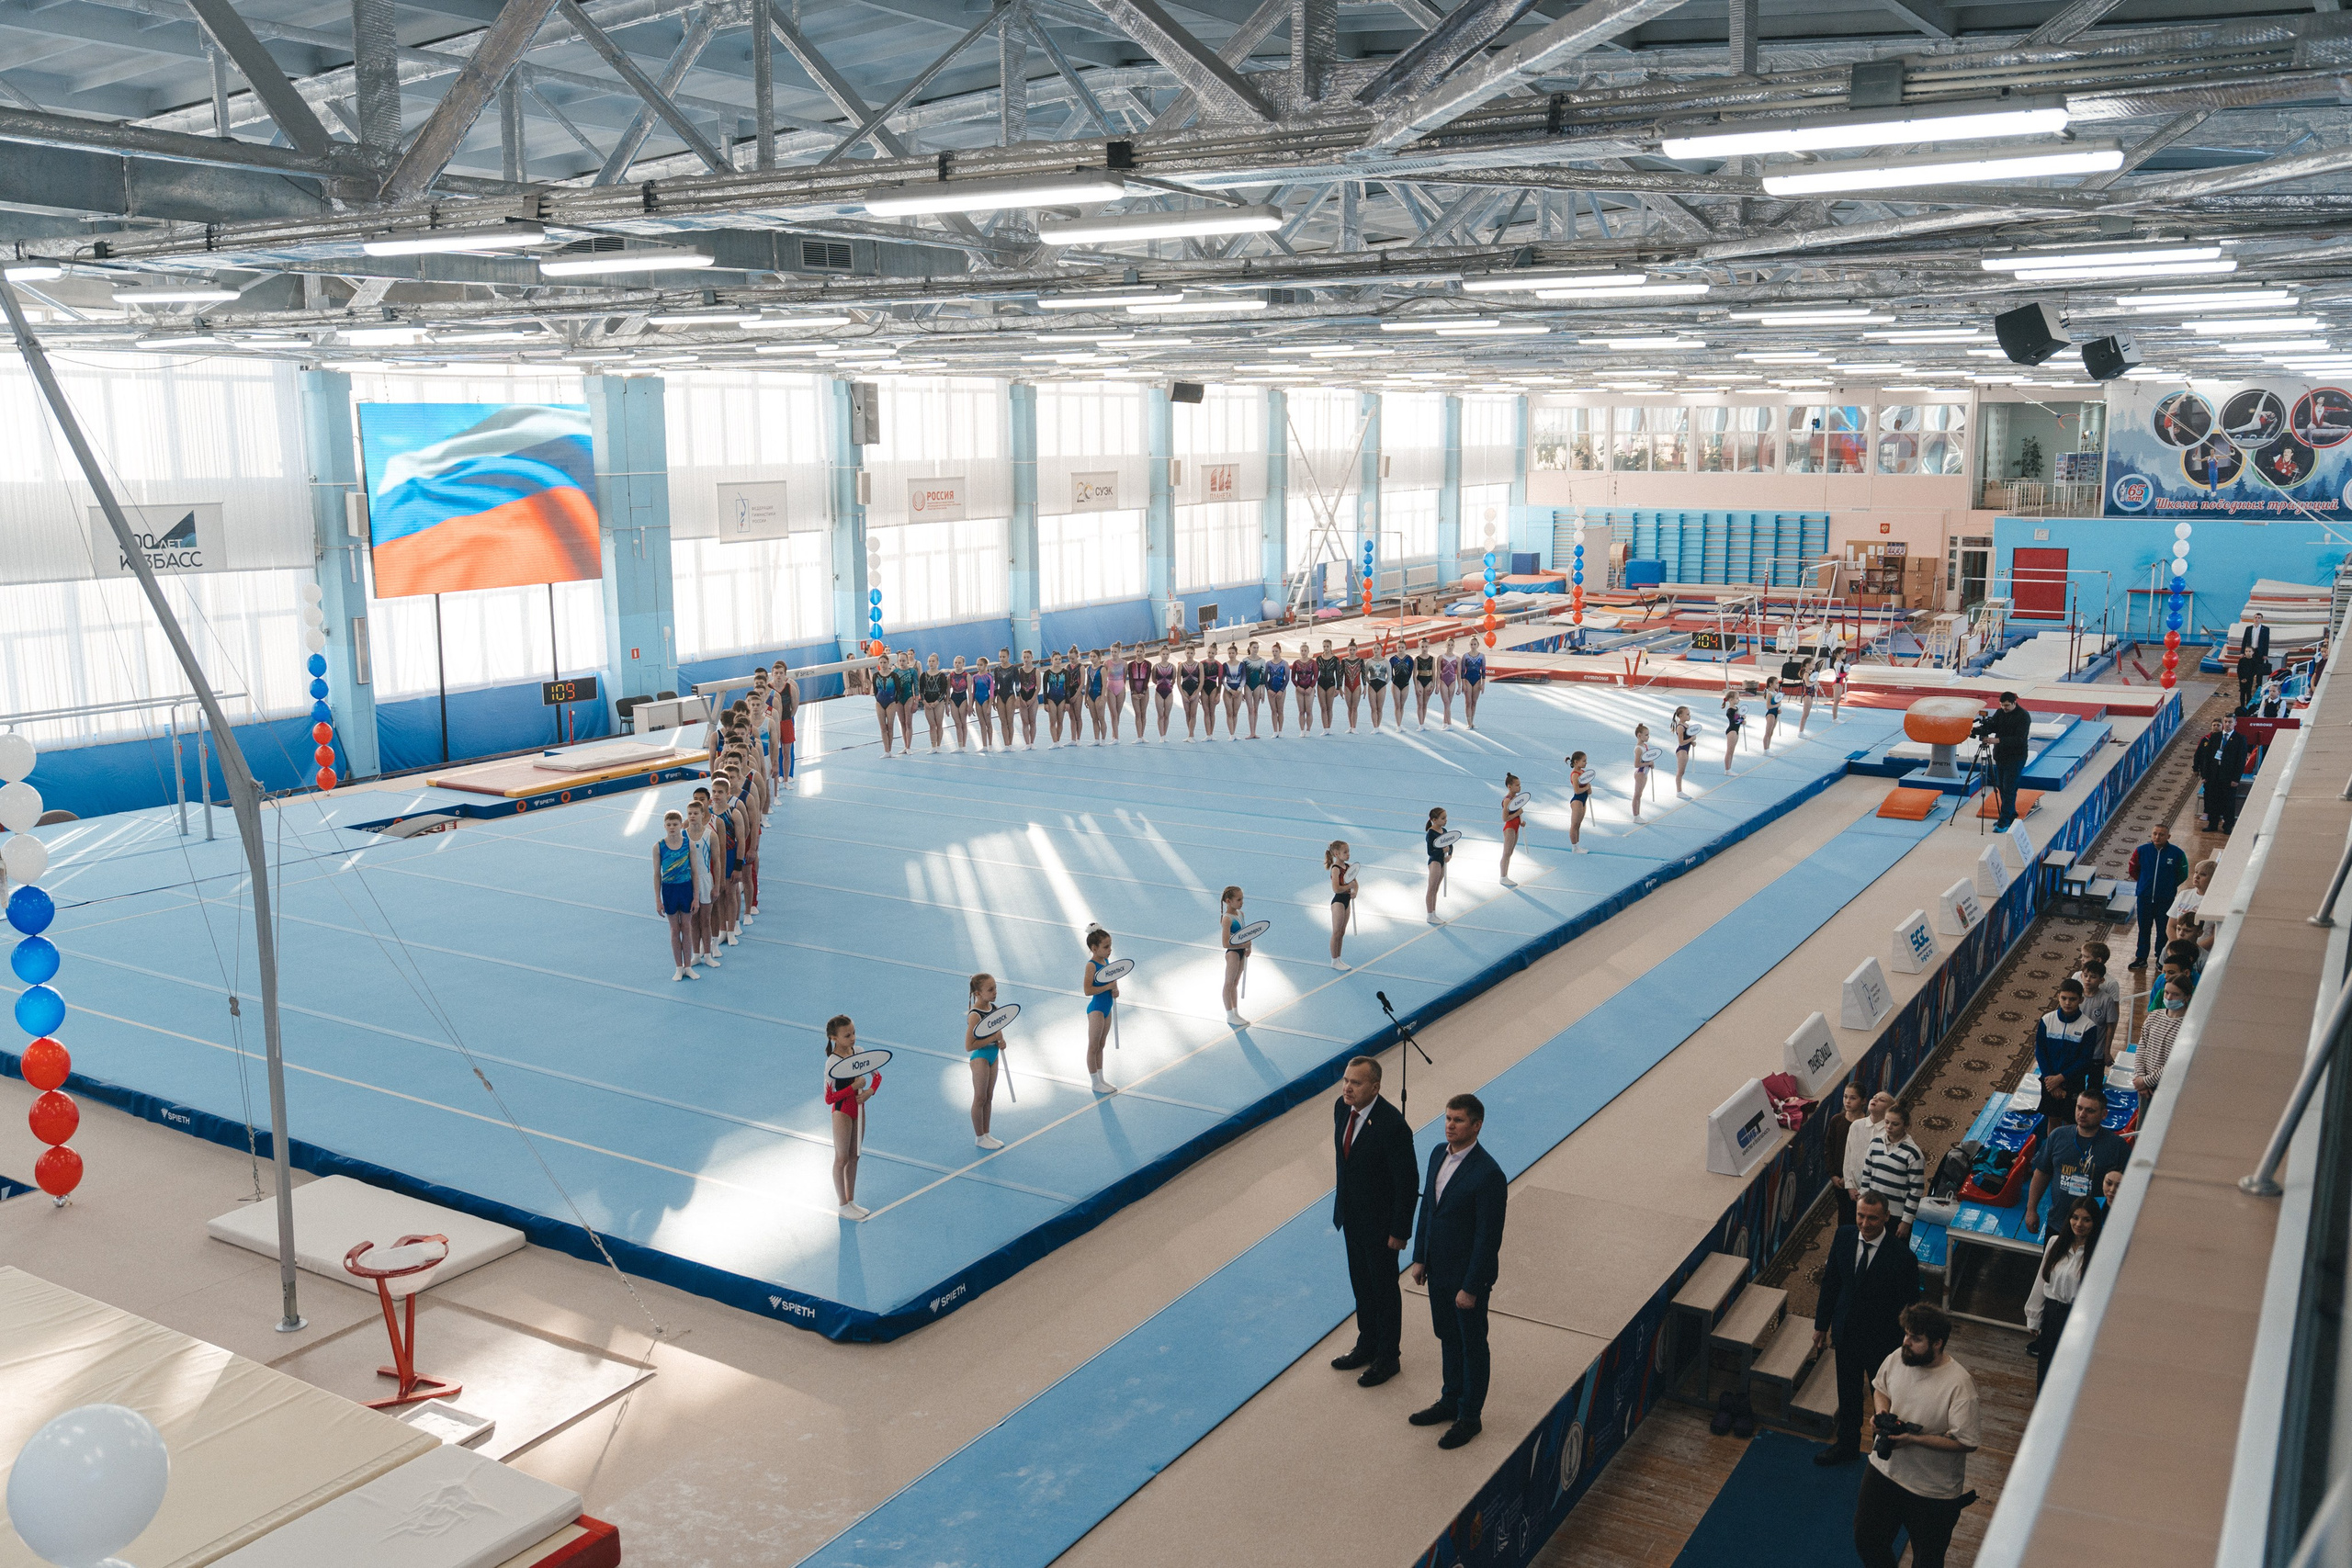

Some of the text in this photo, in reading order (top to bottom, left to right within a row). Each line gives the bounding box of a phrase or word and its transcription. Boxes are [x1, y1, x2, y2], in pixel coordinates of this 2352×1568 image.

[926, 491, 955, 501] РОССИЯ
[1094, 486, 1114, 496] СУЭК
[2127, 483, 2147, 497] 65
[2155, 497, 2340, 514] Школа победных традиций
[119, 551, 203, 570] КЗБАСС
[1698, 634, 1718, 649] 104
[551, 682, 575, 701] 109
[1238, 926, 1262, 941] Красноярск
[1104, 965, 1125, 978] Норильск
[987, 1013, 1008, 1029] Северск
[852, 1059, 870, 1070] Юрга
[167, 1111, 190, 1125] SPIETH
[940, 1283, 967, 1307] SPIETH
[781, 1301, 816, 1318] SPIETH
